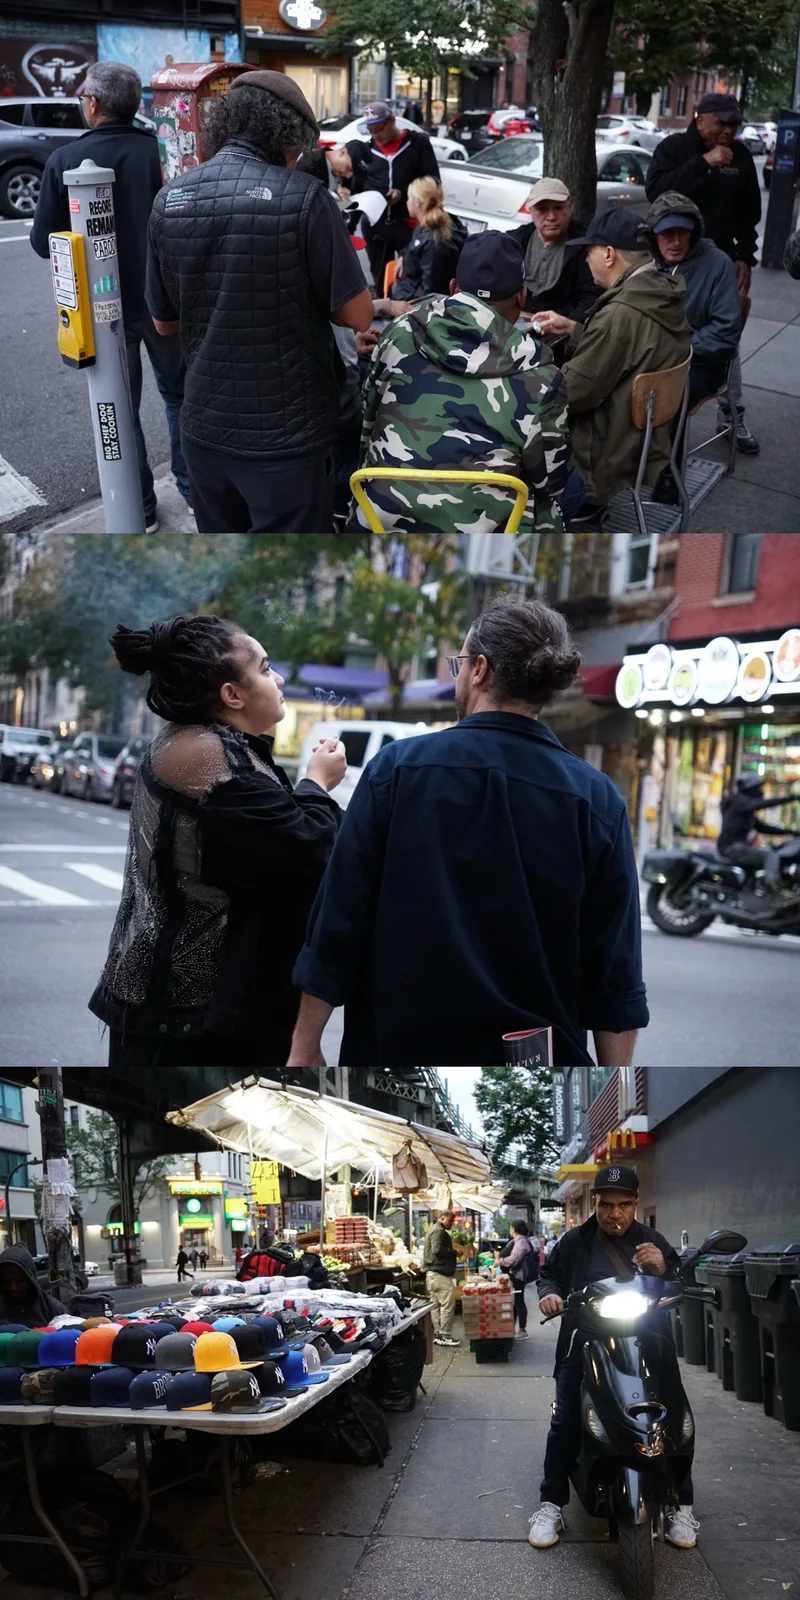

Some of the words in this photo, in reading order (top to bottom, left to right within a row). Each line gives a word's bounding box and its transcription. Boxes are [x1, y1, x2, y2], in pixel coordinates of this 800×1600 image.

[784, 130, 794, 144] P
[98, 403, 108, 423] DOG
[101, 424, 111, 444] CHEF
[104, 446, 113, 460] BIG
[111, 441, 120, 460] STAY
[555, 1085, 564, 1137] McDonald's
[607, 1168, 621, 1182] B
